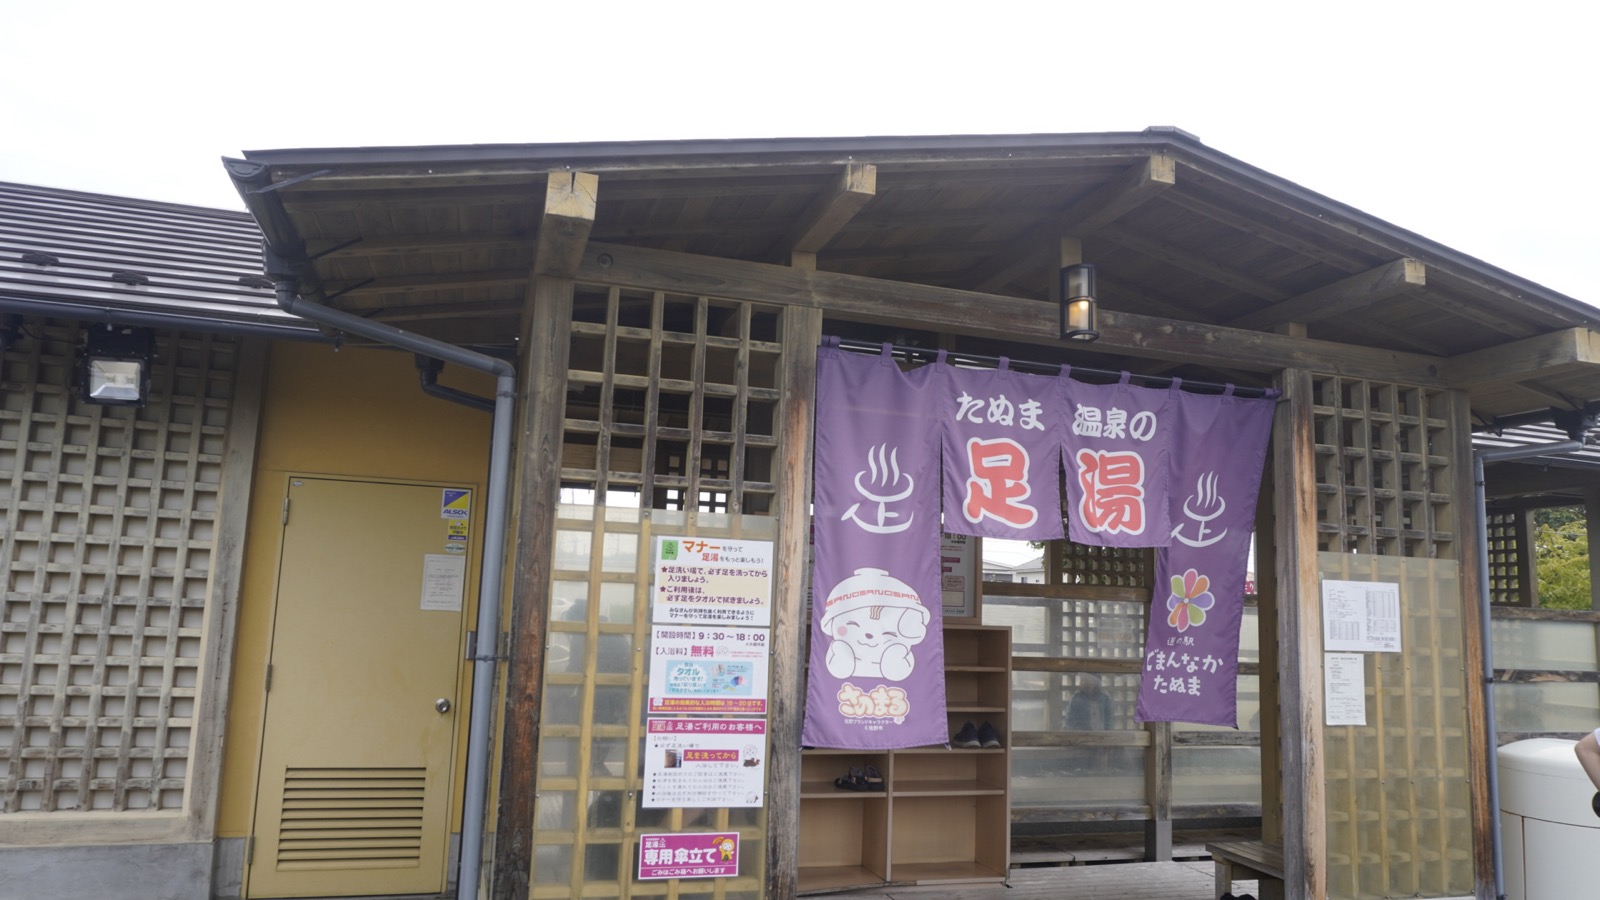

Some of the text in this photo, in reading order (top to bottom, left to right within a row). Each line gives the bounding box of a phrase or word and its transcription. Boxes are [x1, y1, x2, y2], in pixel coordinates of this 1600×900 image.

[955, 390, 1157, 442] たぬま 温泉の
[962, 436, 1146, 536] 足 湯
[442, 508, 468, 516] ALSOK
[1166, 635, 1195, 646] 道の駅
[690, 645, 714, 658] 無料
[676, 667, 700, 676] タオル
[1153, 674, 1201, 696] たぬま
[837, 681, 910, 718] さのまる
[675, 721, 763, 731] 足湯ご利用のお客様へ
[685, 751, 737, 761] 足を洗ってから
[643, 847, 717, 865] 専用傘立て
